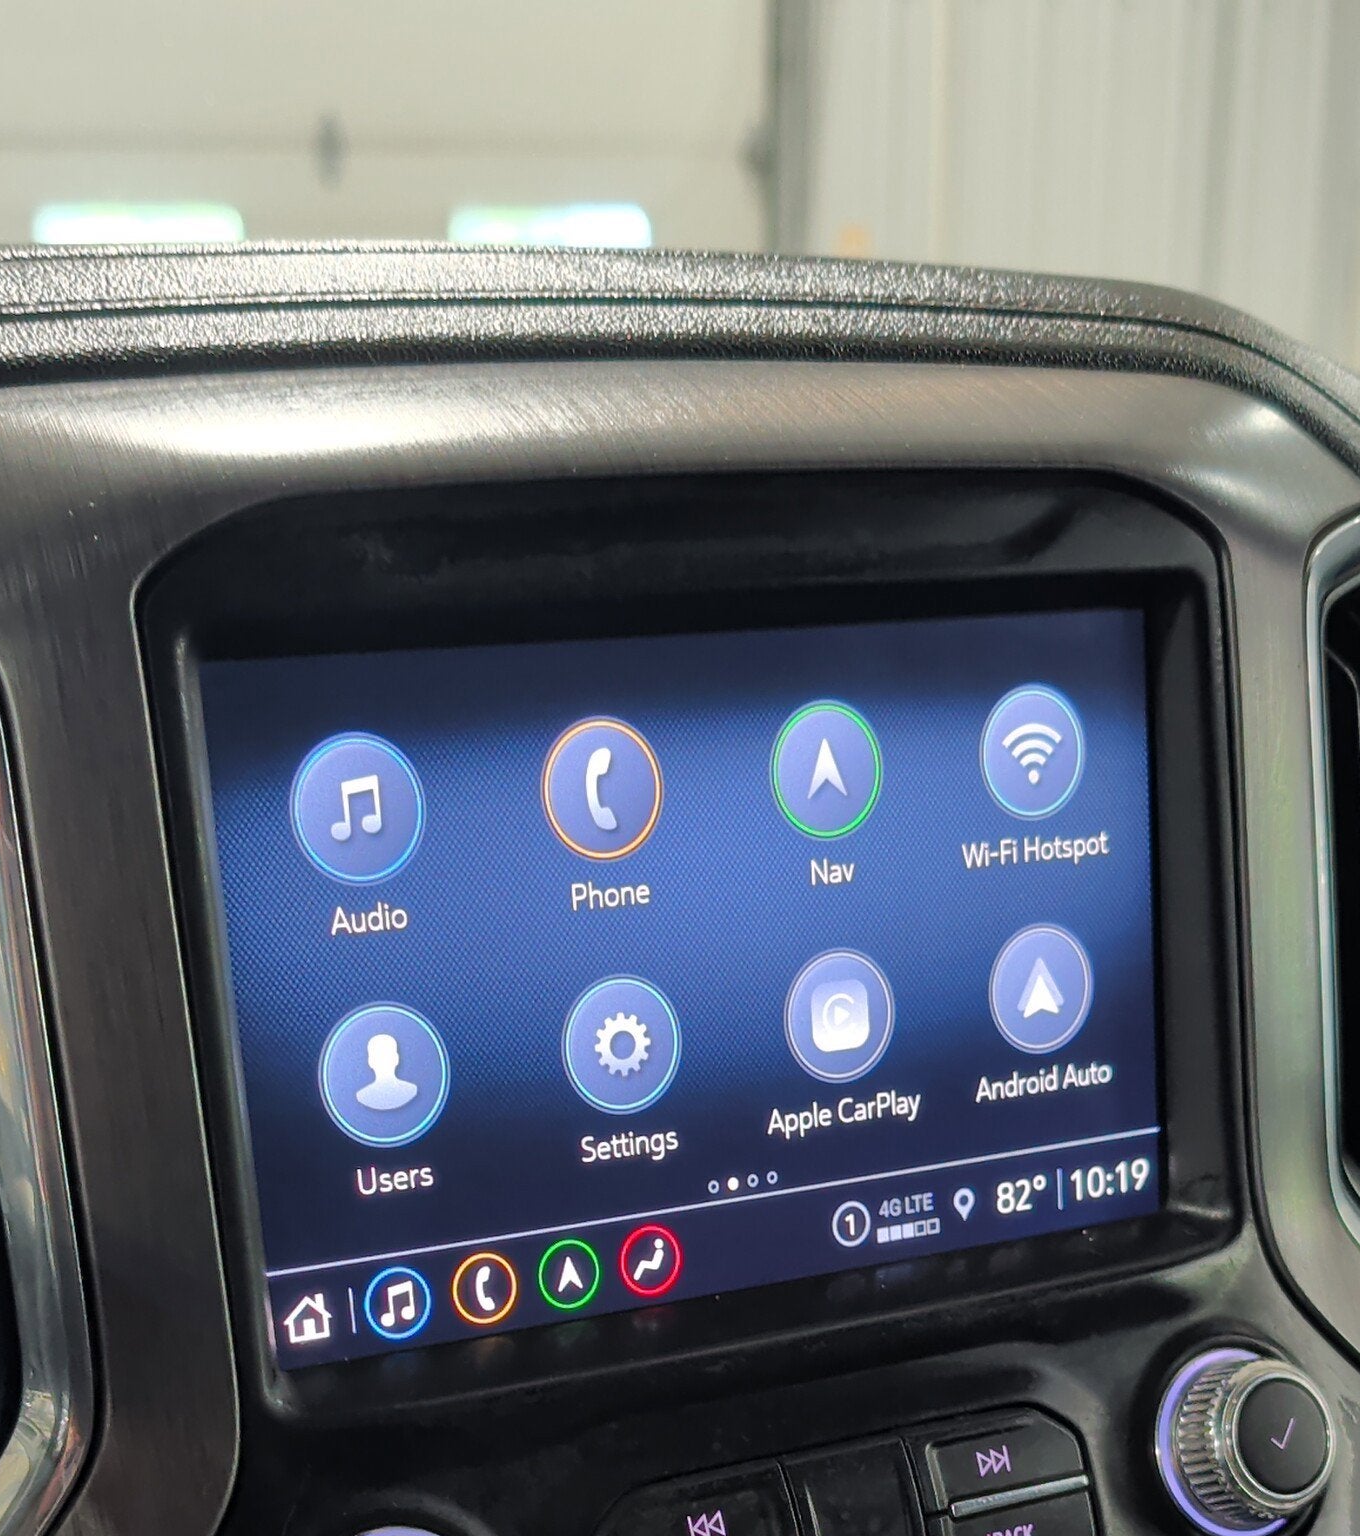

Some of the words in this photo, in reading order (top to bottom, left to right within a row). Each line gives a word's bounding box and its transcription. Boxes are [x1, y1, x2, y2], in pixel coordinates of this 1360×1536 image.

[962, 838, 1018, 869] Wi-Fi
[1024, 831, 1110, 863] Hotspot
[810, 859, 855, 886] Nav
[571, 882, 651, 911] Phone
[331, 902, 408, 935] Audio
[975, 1065, 1059, 1103] Android
[1062, 1061, 1114, 1090] Auto
[767, 1101, 832, 1140] Apple
[838, 1089, 922, 1124] CarPlay
[580, 1130, 679, 1163] Settings
[356, 1165, 434, 1195] Users
[1070, 1158, 1151, 1202] 10:19
[878, 1196, 902, 1218] 4G
[904, 1192, 935, 1214] LTE
